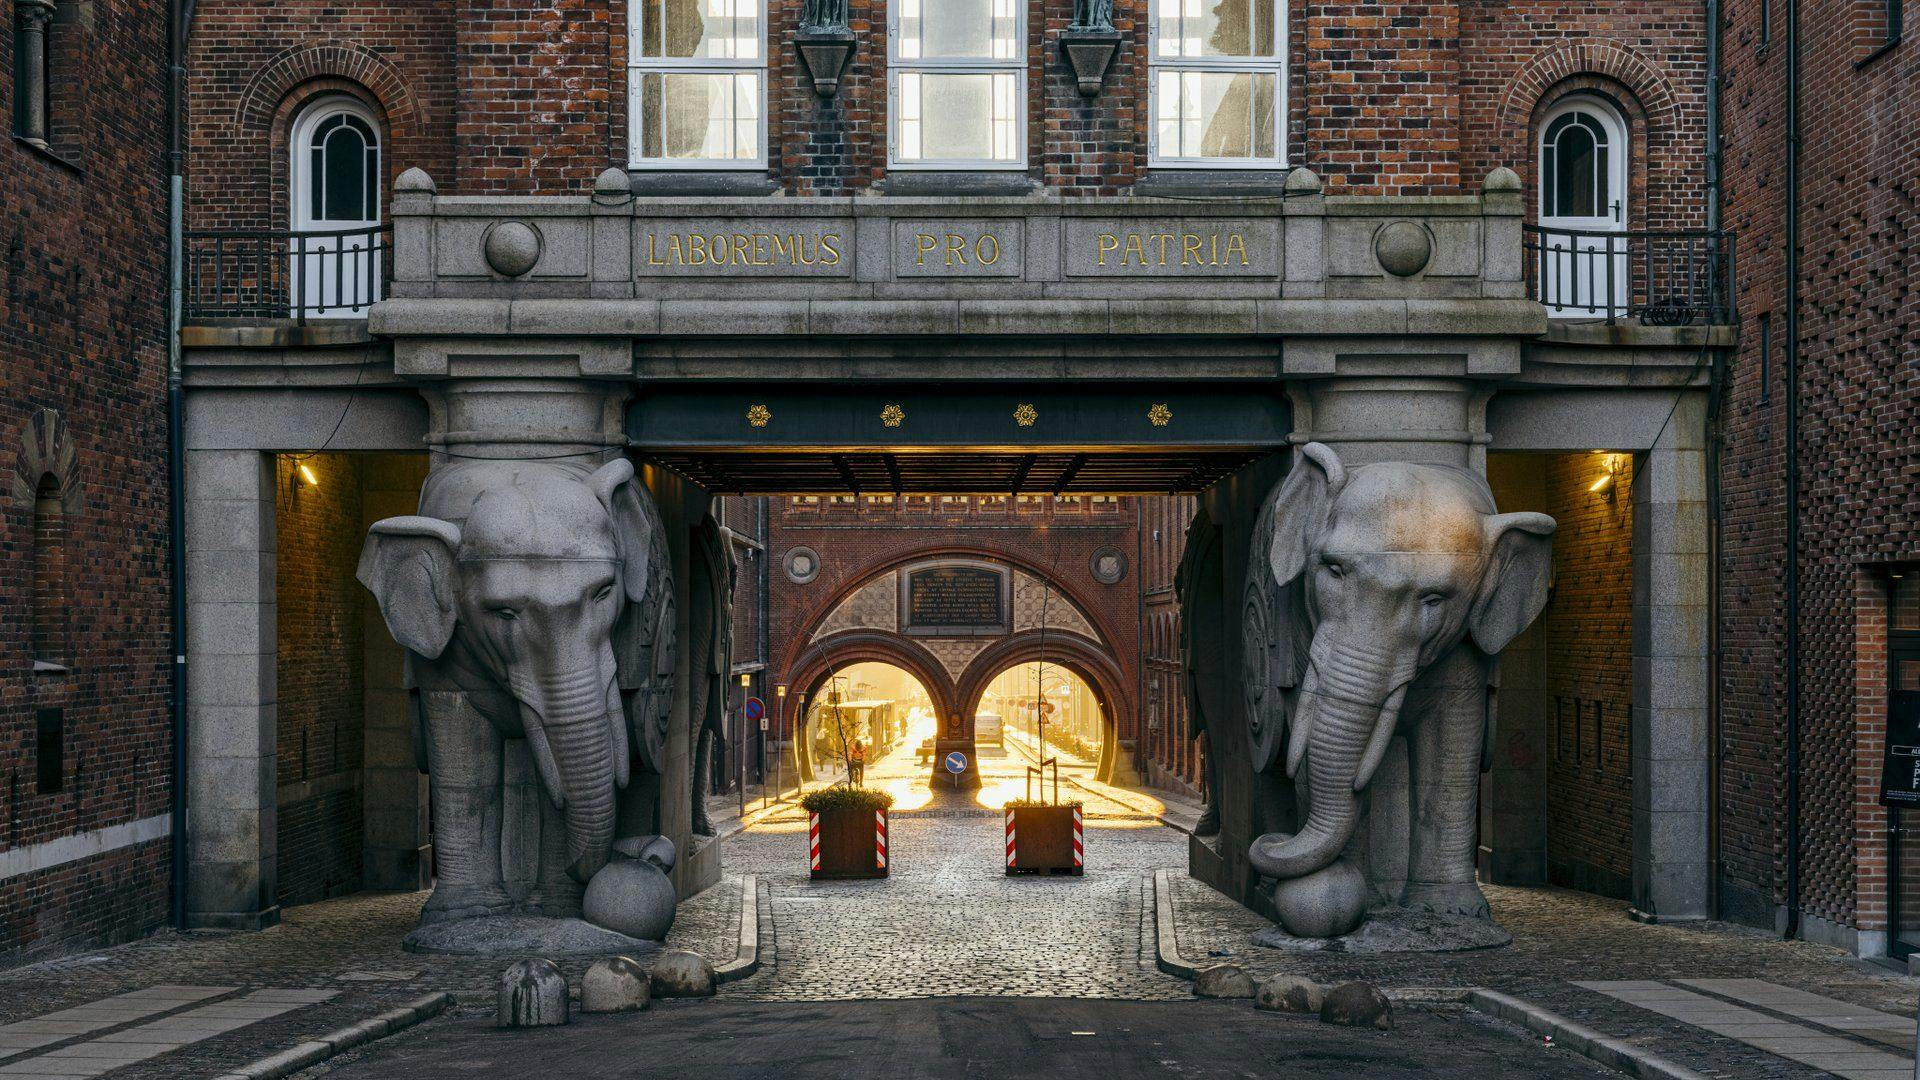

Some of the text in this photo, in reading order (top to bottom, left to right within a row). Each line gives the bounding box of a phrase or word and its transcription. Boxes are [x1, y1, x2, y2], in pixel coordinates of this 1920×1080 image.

[648, 233, 1249, 266] LABOREMUS PRO PATRIA
